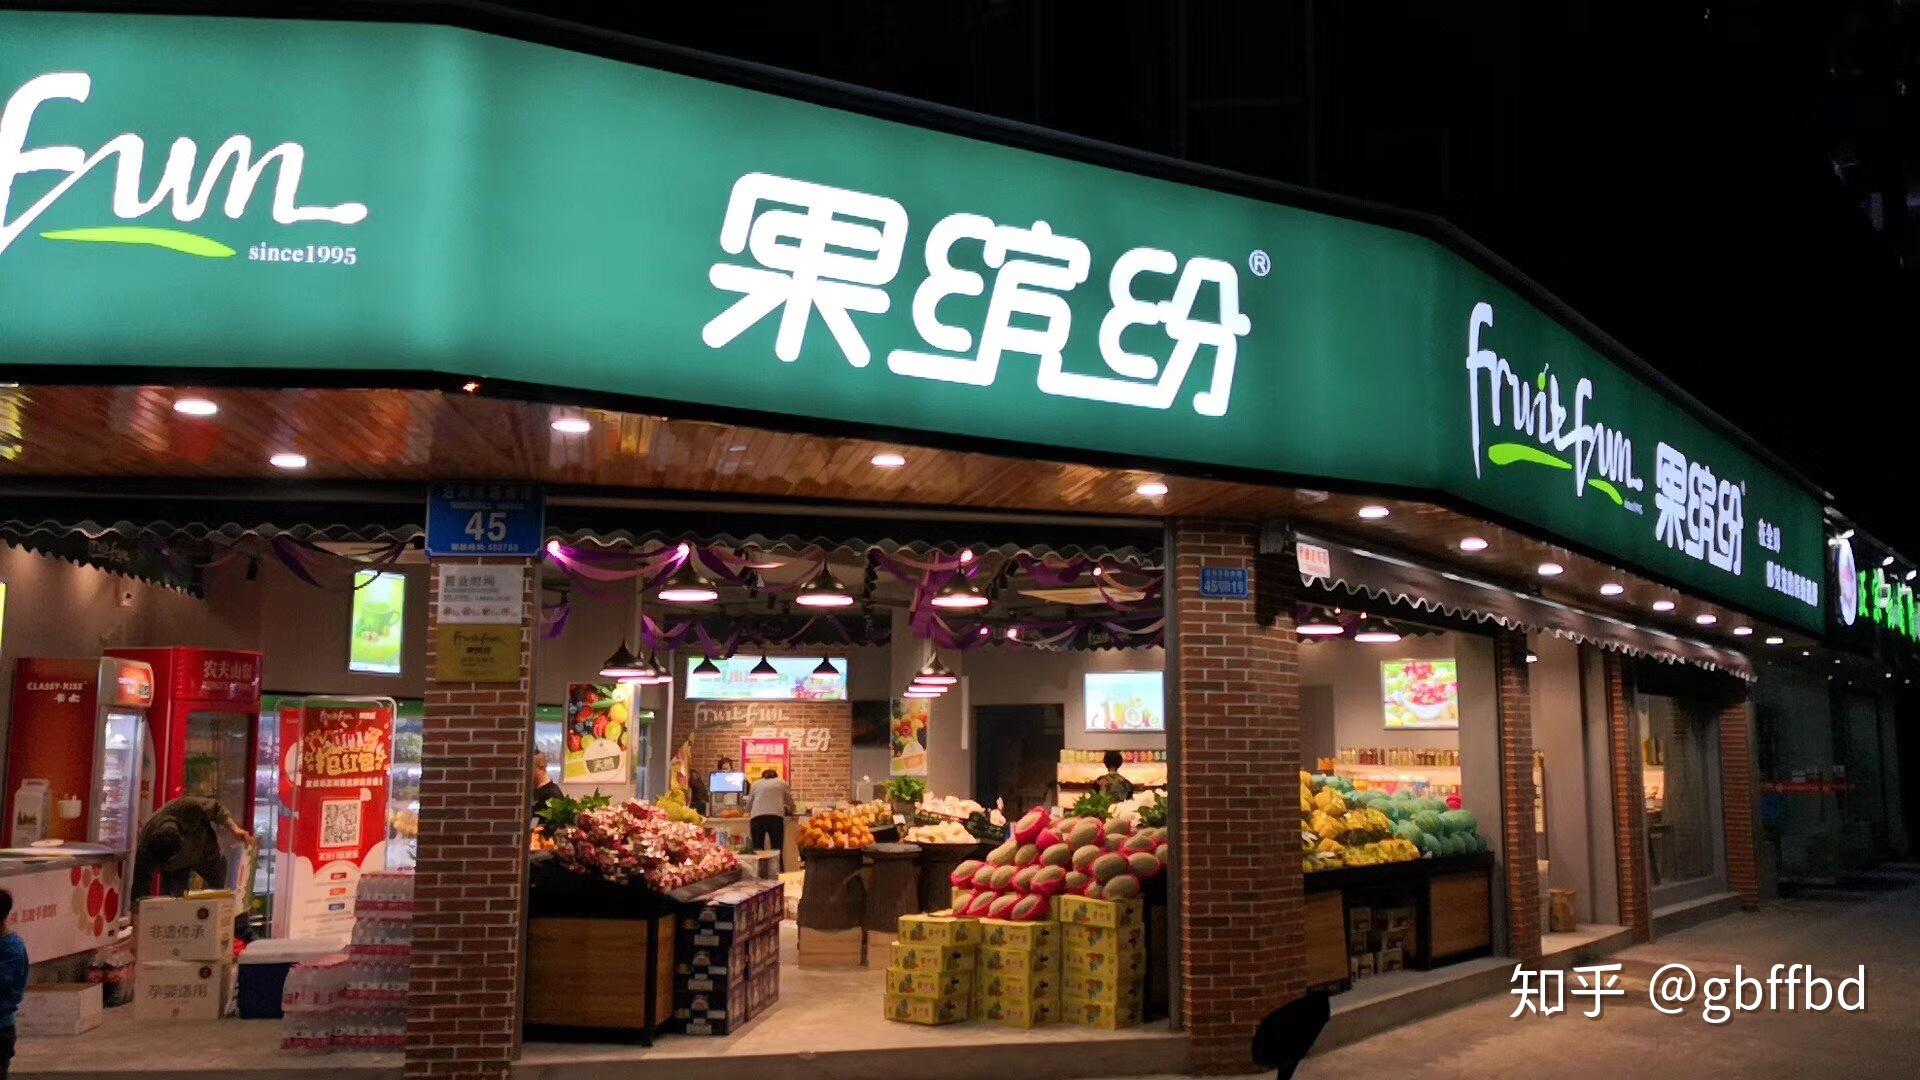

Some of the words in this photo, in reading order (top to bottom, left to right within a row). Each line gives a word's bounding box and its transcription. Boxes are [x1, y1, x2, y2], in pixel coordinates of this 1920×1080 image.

[248, 241, 357, 266] since1995
[702, 172, 1251, 417] 果缤纷
[464, 511, 507, 542] 45
[1654, 441, 1744, 576] 果缤纷
